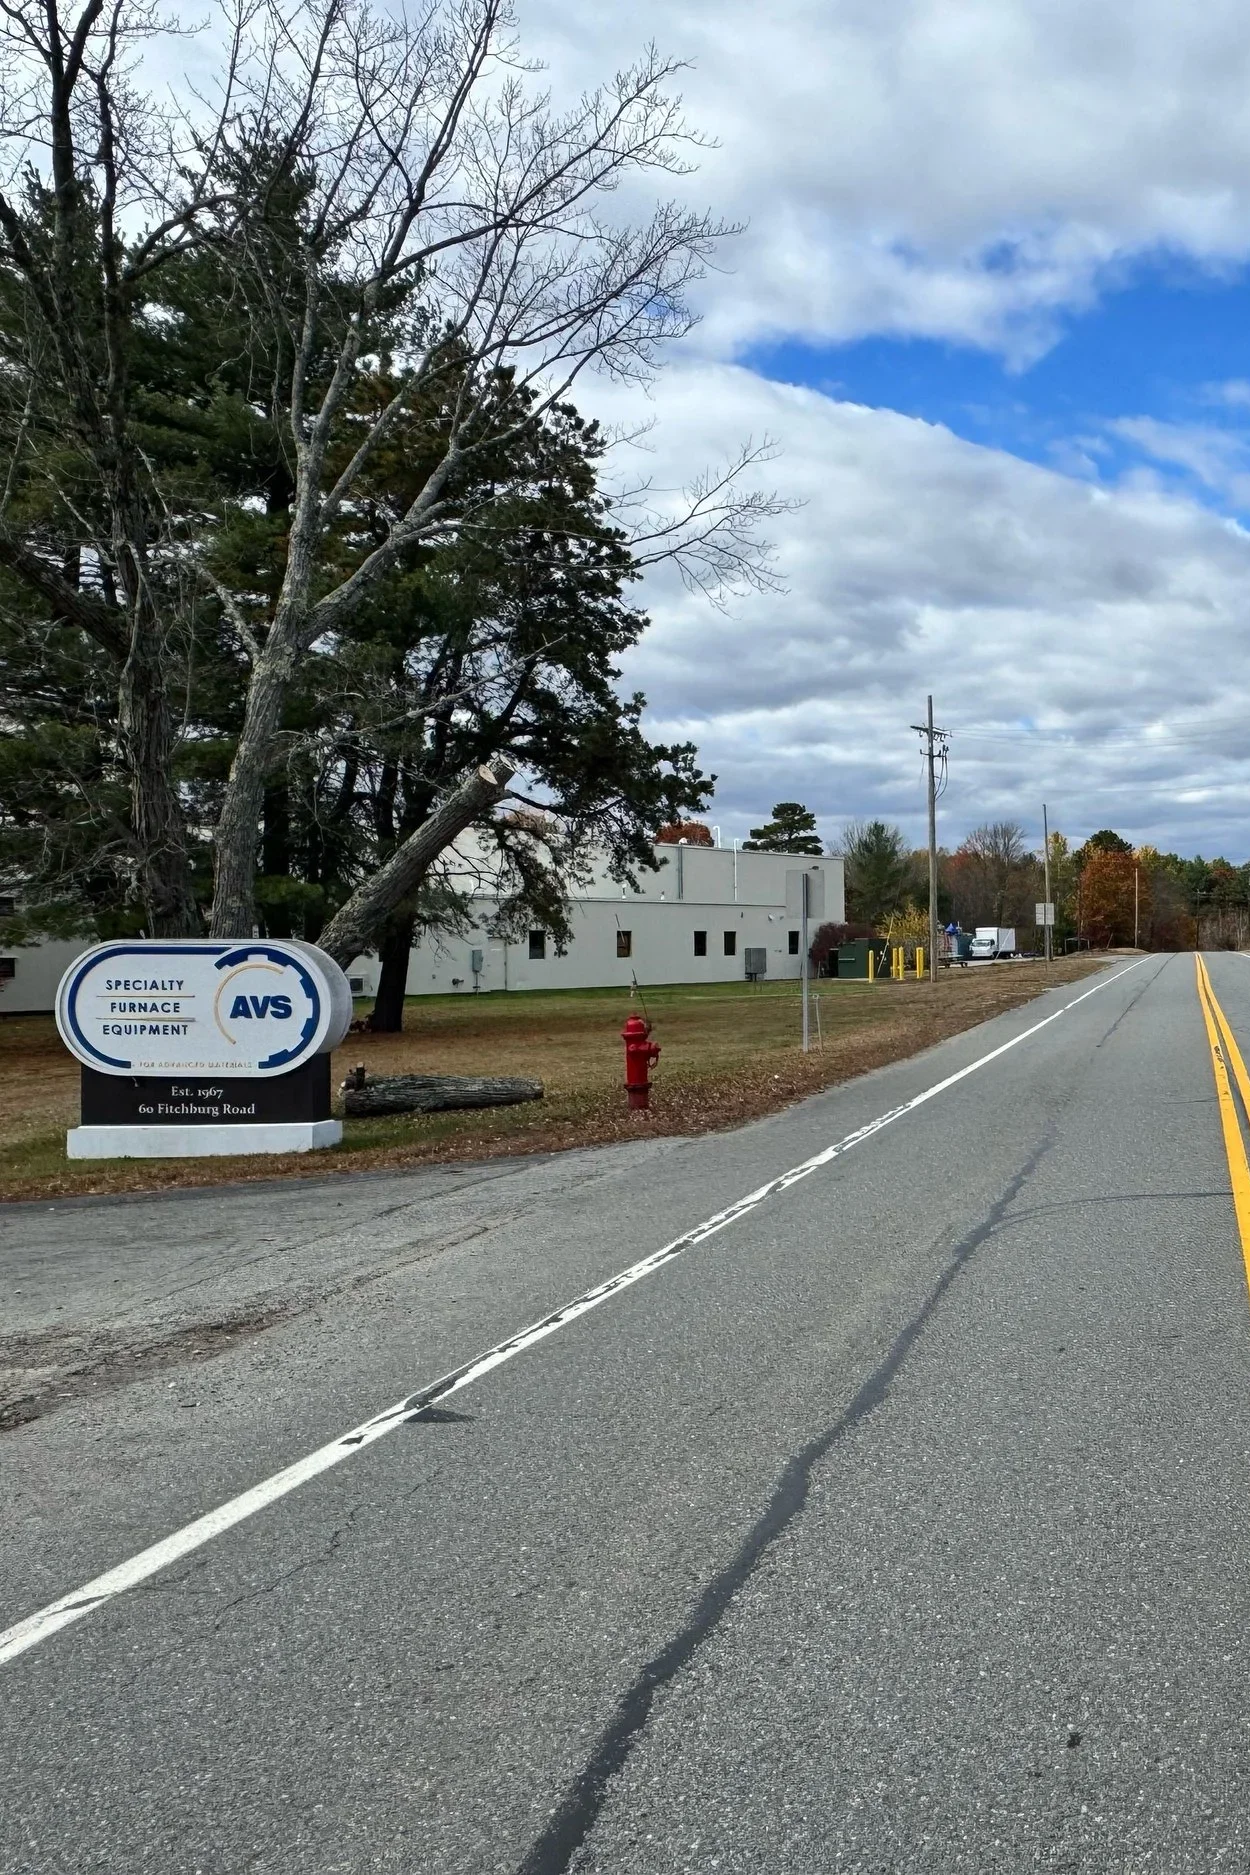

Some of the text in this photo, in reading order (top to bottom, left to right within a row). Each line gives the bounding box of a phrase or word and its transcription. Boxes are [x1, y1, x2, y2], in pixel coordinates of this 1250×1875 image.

[105, 979, 185, 991] SPECIALTY
[110, 1002, 181, 1014] FURNACE
[229, 995, 293, 1020] AVS
[102, 1024, 189, 1036] EQUIPMENT
[171, 1085, 224, 1099] Est. 1967
[138, 1102, 256, 1117] 60 Fitchburg Road
